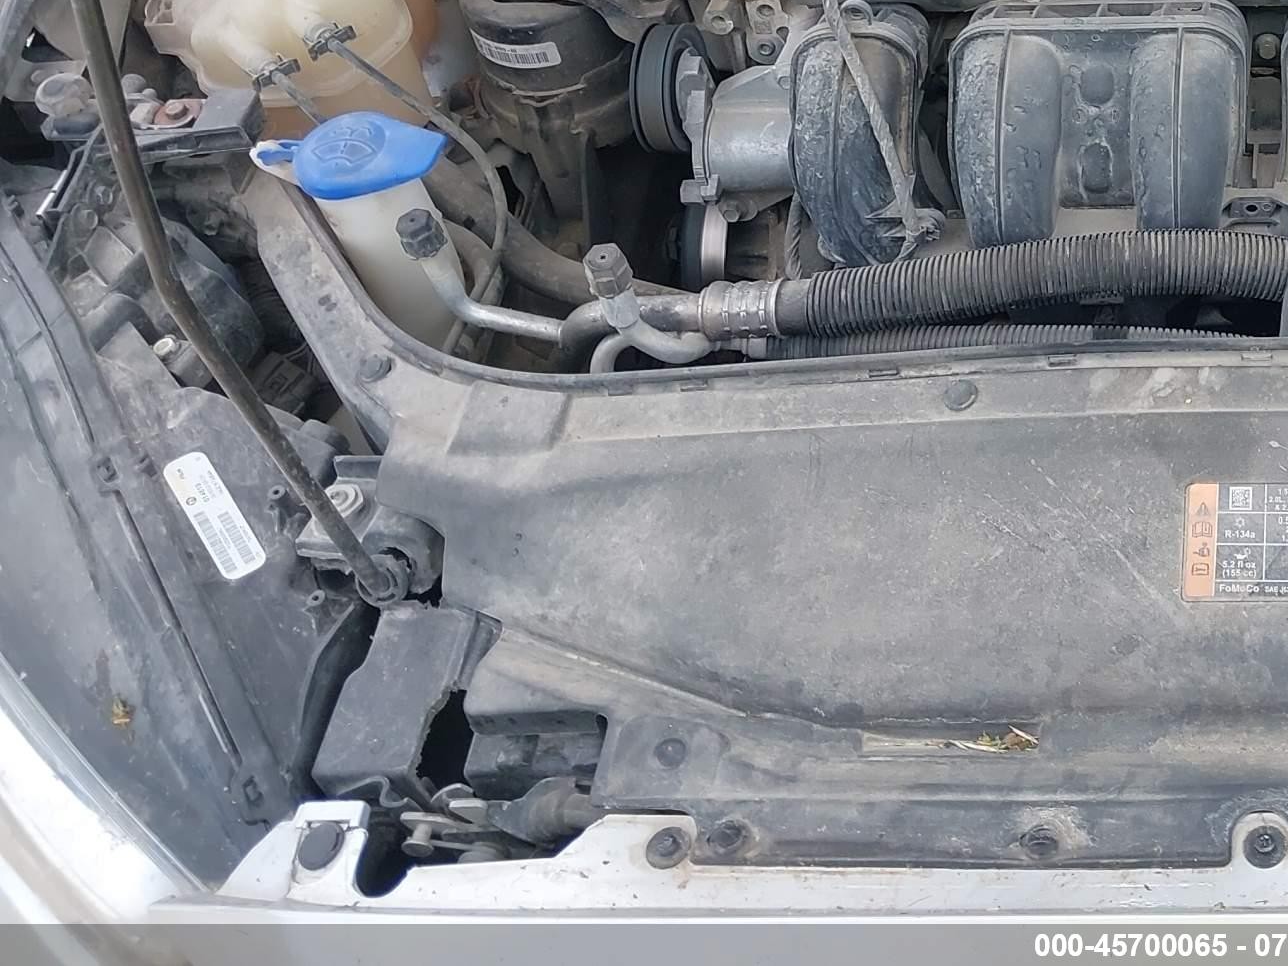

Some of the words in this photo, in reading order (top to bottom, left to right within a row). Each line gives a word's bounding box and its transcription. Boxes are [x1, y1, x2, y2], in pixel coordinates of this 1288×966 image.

[1224, 529, 1256, 539] R-134a
[1222, 560, 1235, 569] 5.2
[1237, 560, 1244, 568] fl
[1222, 569, 1240, 579] (155
[1219, 584, 1260, 593] FoMoCo
